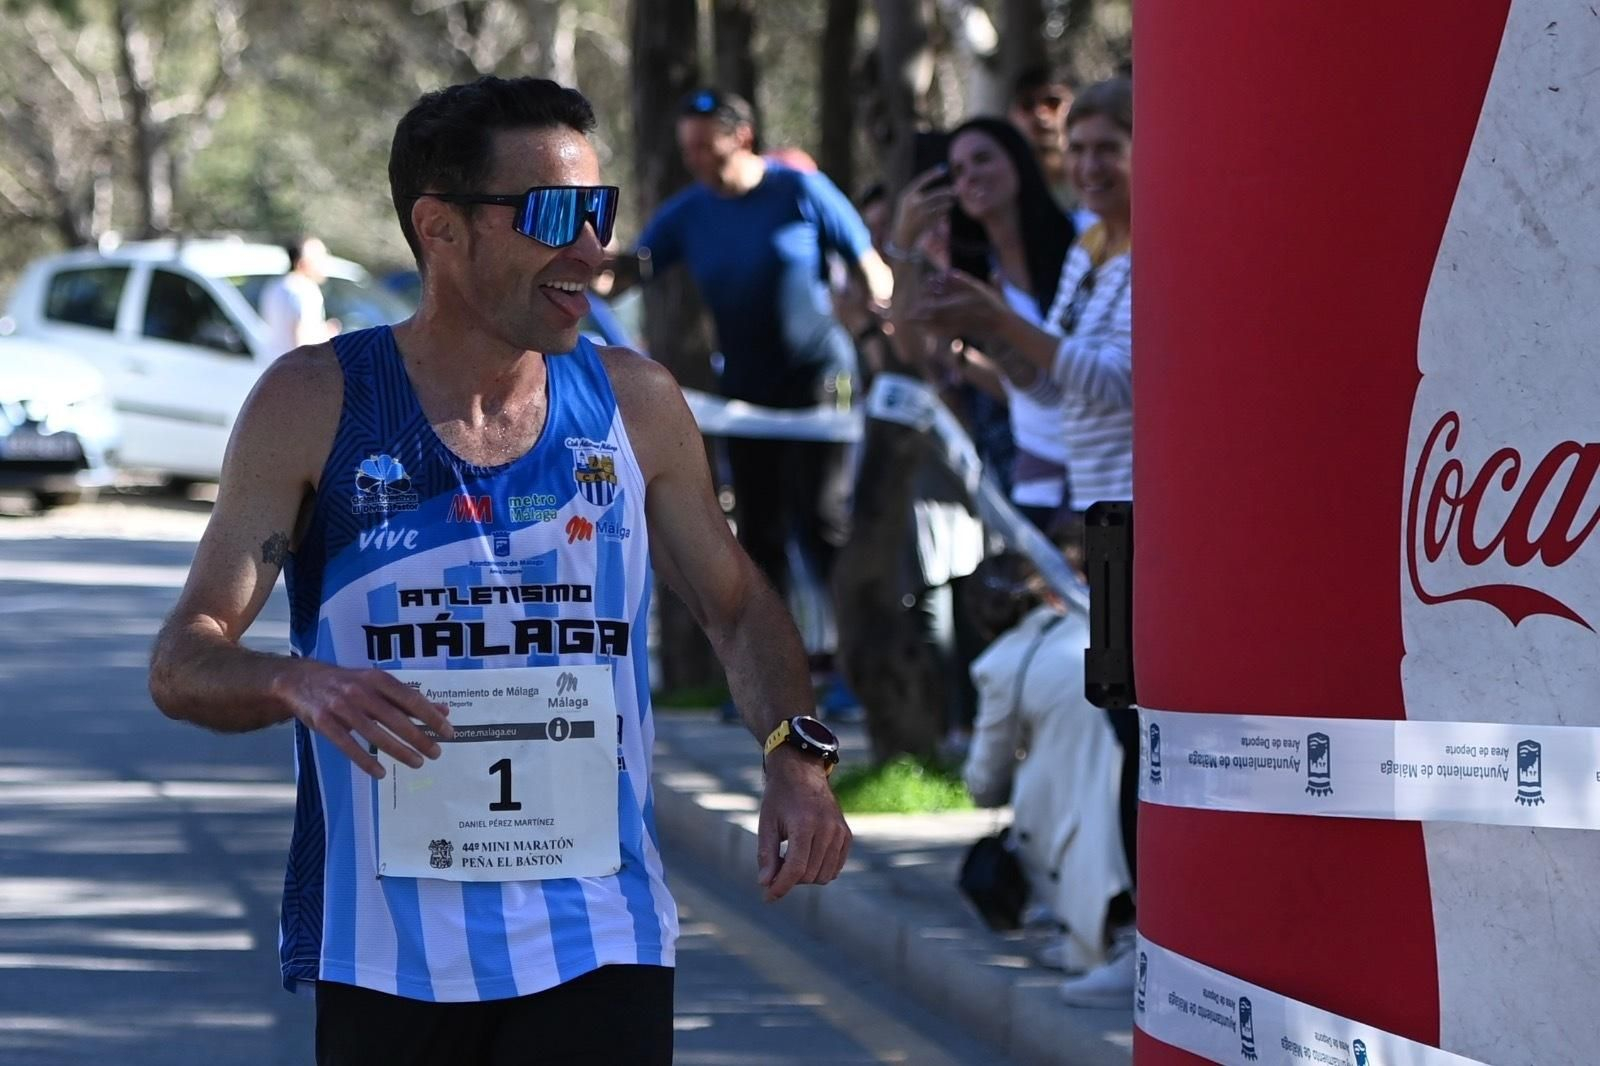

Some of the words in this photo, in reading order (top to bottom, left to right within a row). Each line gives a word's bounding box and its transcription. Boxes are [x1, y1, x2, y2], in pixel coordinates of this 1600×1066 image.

[509, 493, 556, 508] metro
[510, 507, 558, 523] Málaga
[1406, 411, 1600, 633] Coca
[359, 523, 419, 552] vive
[398, 584, 593, 608] ATLETISMO
[362, 612, 630, 661] MÁLAGA
[426, 688, 490, 700] Ayuntamiento
[492, 687, 504, 698] de
[506, 686, 540, 699] Málaga
[547, 696, 589, 710] Málaga
[1241, 736, 1270, 749] Deporte
[1271, 737, 1282, 749] de
[1282, 738, 1300, 753] Área
[1445, 744, 1477, 757] Deporte
[1478, 745, 1489, 757] de
[1490, 746, 1510, 762] Área
[1188, 750, 1218, 769] Málaga
[1219, 755, 1231, 770] de
[1232, 755, 1300, 773] Ayuntamiento
[1380, 759, 1418, 779] Málaga
[1420, 763, 1433, 778] de
[1436, 762, 1510, 782] Ayuntamiento
[488, 758, 522, 812] 1
[458, 820, 487, 829] DANIEL
[489, 818, 513, 828] PÉREZ
[514, 817, 555, 827] MARTÍNEZ
[481, 841, 510, 853] MINI
[513, 836, 575, 851] MARATÓN
[462, 855, 494, 868] PEÑA
[497, 856, 513, 868] EL
